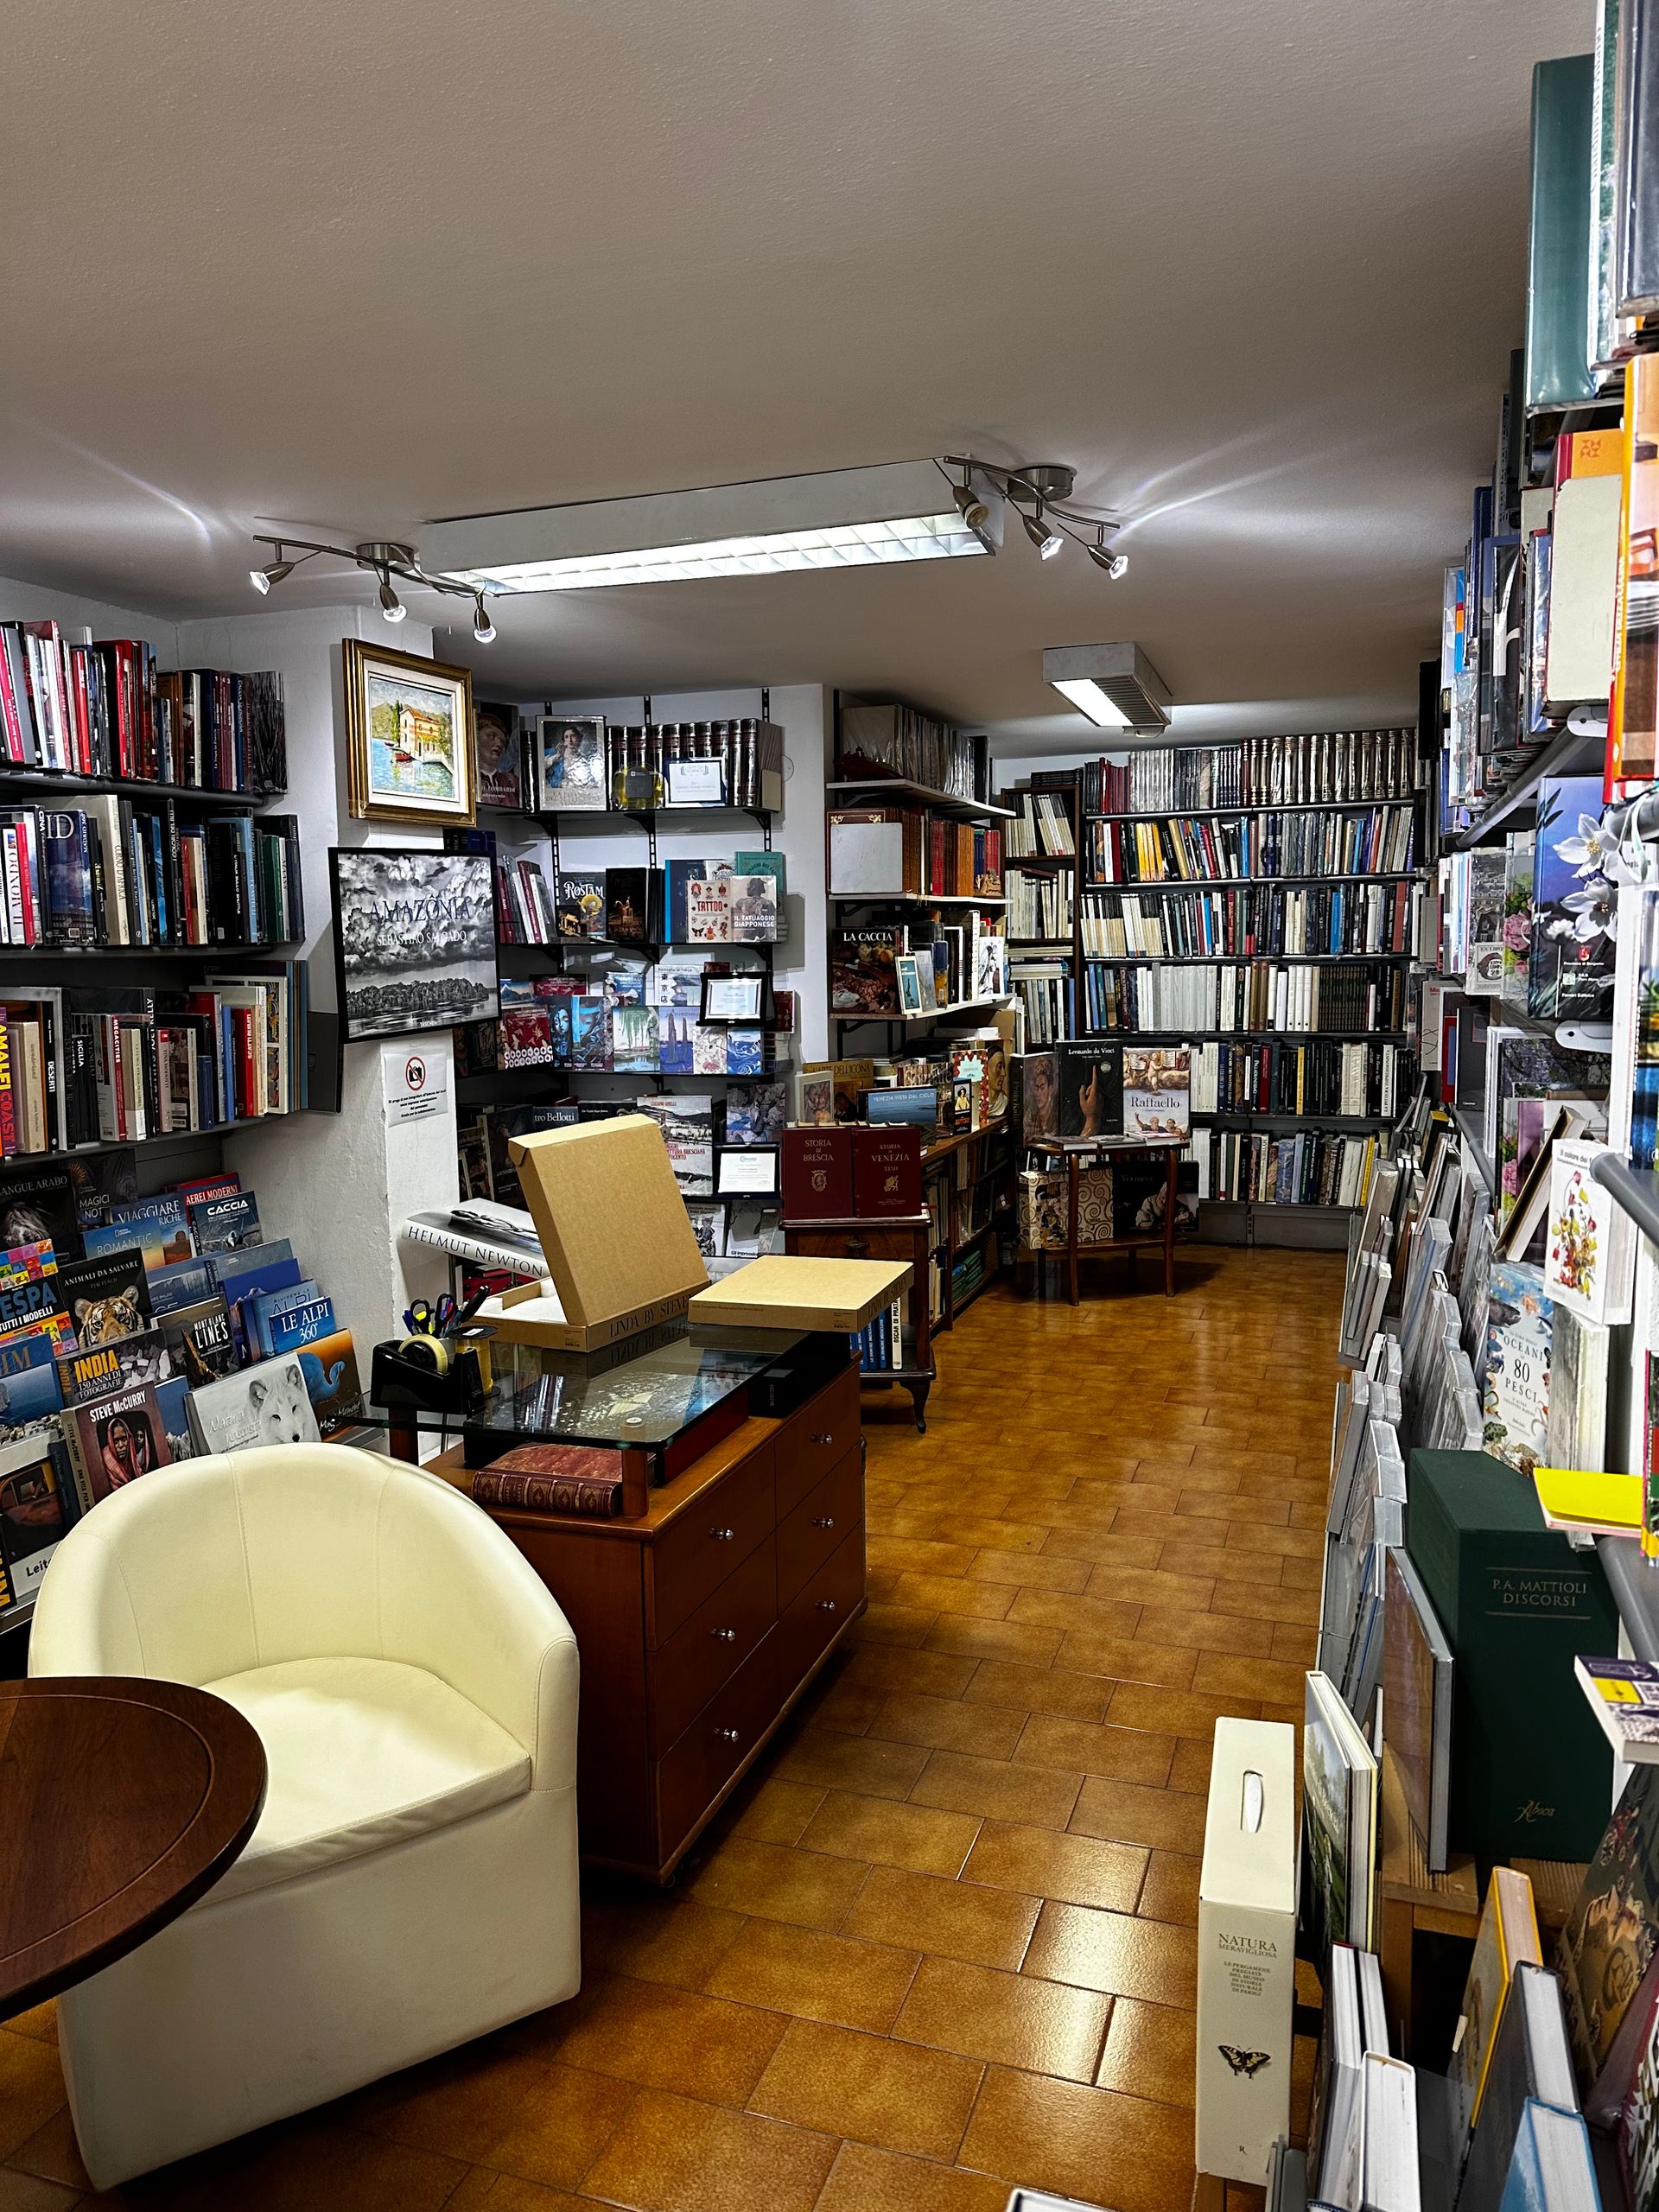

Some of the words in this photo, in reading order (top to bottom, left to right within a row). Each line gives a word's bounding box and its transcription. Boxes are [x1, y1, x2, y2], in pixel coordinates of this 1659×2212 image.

[114, 844, 124, 868] CORNO
[8, 852, 22, 908] MONDO
[117, 868, 126, 901] D'AFRICA
[563, 880, 606, 900] ROSTAM
[370, 895, 472, 923] AMAZÔNIA
[696, 900, 723, 912] TATTOO
[843, 932, 855, 942] LA
[858, 931, 893, 942] CACCIA
[48, 1060, 56, 1093] DESERTI
[834, 1064, 871, 1075] DELL'ICONA
[1130, 1096, 1180, 1109] Raffaello
[0, 1091, 16, 1142] COAST
[547, 1112, 575, 1122] Bellotti
[804, 1139, 832, 1147] STORIA
[803, 1154, 834, 1162] BRESCIA
[871, 1154, 910, 1162] VENEZIA
[0, 1181, 35, 1197] ANGUE
[36, 1175, 68, 1190] ARABO
[186, 1192, 207, 1206] AEREI
[207, 1184, 238, 1201] MODERNI
[79, 1194, 110, 1209] MAGICI
[118, 1199, 181, 1224] VIAGGIARE
[207, 1198, 249, 1217] CACCIA
[97, 1232, 153, 1257] ROMANTIC
[192, 1219, 200, 1249] CACCIA
[408, 1225, 470, 1255] HELMUT
[475, 1246, 543, 1276] NEWTON
[64, 1273, 96, 1287] ANIMALI
[97, 1269, 109, 1279] DA
[109, 1260, 140, 1274] SALVARE
[1, 1281, 58, 1320] ESPA
[0, 1319, 19, 1332] TUTTI
[22, 1306, 54, 1324] MODELLI
[208, 1313, 226, 1327] BLANC
[281, 1313, 297, 1333] LE
[302, 1301, 330, 1326] ALPI
[609, 1314, 639, 1338] LINDA
[644, 1308, 654, 1325] BY
[194, 1321, 229, 1350] LINES
[1503, 1334, 1543, 1362] OCEANI
[74, 1349, 120, 1383] INDIA
[1514, 1358, 1530, 1383] 80
[59, 1364, 71, 1394] INDIA
[79, 1381, 92, 1392] 150
[92, 1374, 111, 1387] ANNI
[112, 1370, 122, 1380] DI
[79, 1378, 123, 1400] FOTOGRAFIE
[1505, 1376, 1537, 1403] PESCI
[89, 1404, 113, 1423] STEVE
[114, 1389, 146, 1413] McCURRY
[67, 1423, 75, 1441] STEVE
[71, 1441, 80, 1462] McCURRY
[1519, 1580, 1587, 1595] MATTIOLI
[1503, 1592, 1577, 1608] DISCORSI
[1218, 1933, 1277, 1953] NATURA
[1218, 1942, 1277, 1959] MERAVIGLIOSA
[1232, 1962, 1271, 1974] PERGAMENE
